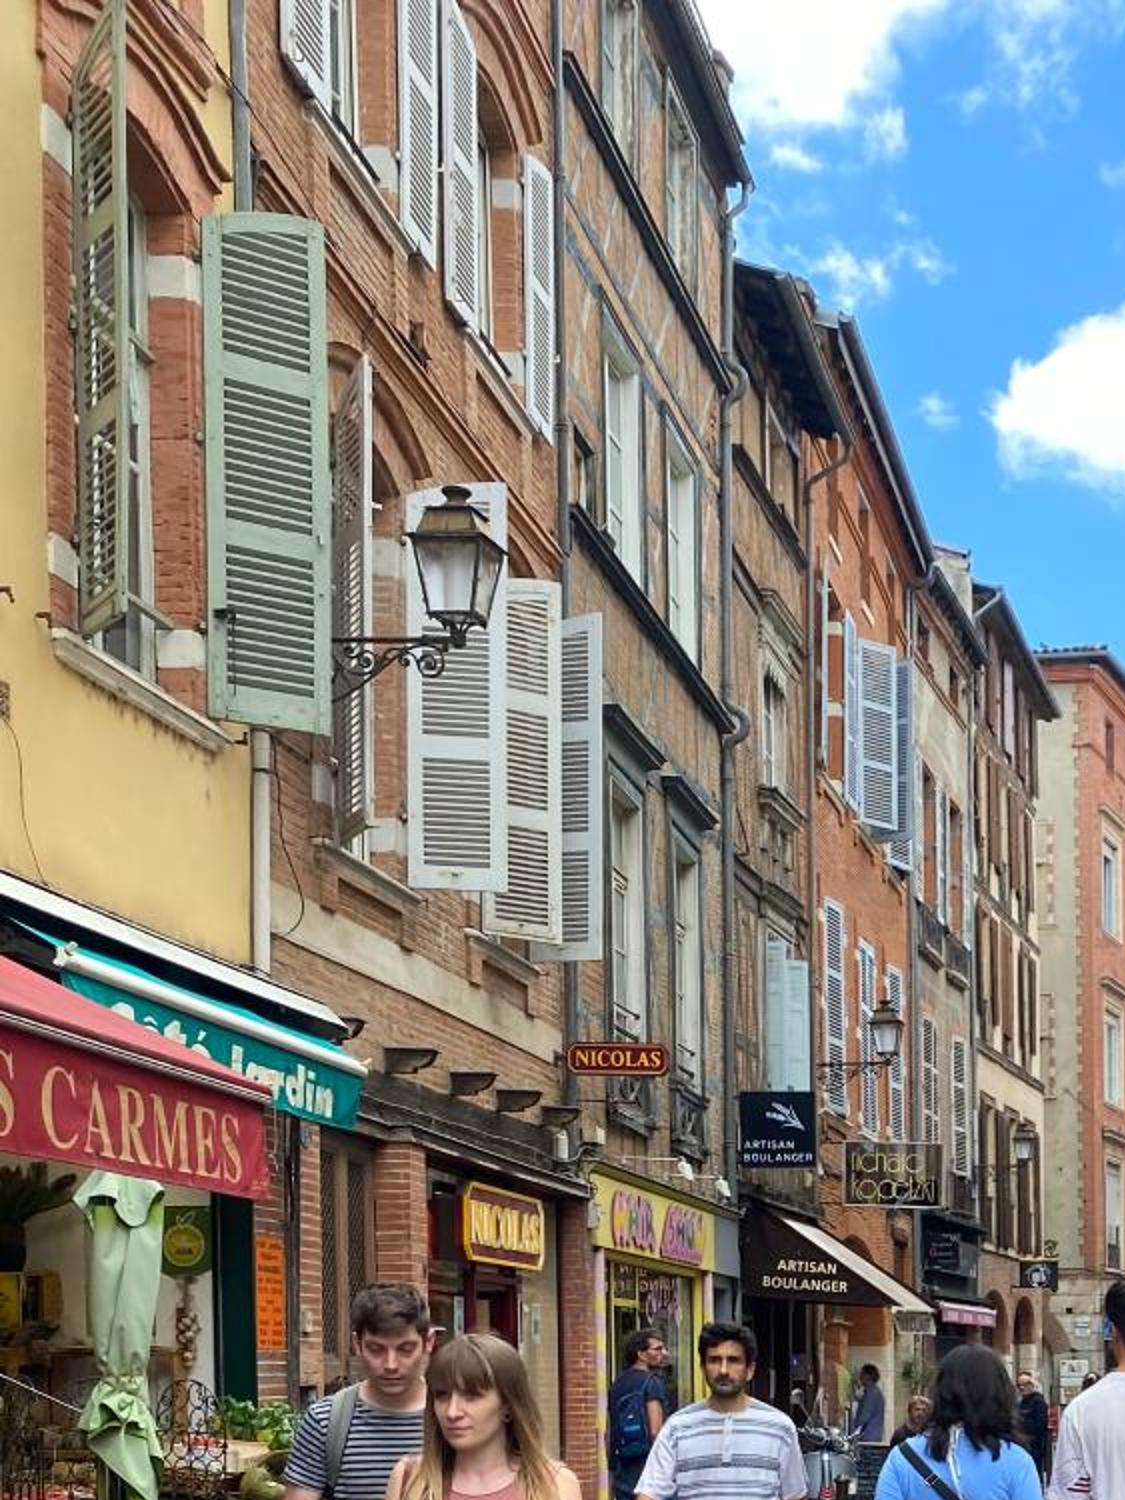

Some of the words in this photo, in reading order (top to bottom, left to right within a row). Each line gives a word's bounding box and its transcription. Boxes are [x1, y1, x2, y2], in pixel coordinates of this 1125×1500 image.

[574, 1049, 661, 1068] NICOLAS
[41, 1066, 242, 1184] CARMES
[743, 1139, 795, 1150] ARTISAN
[743, 1152, 814, 1163] BOULANGER
[470, 1199, 541, 1254] NICOLAS
[777, 1258, 838, 1275] ARTISAN
[761, 1275, 849, 1294] BOULANGER
